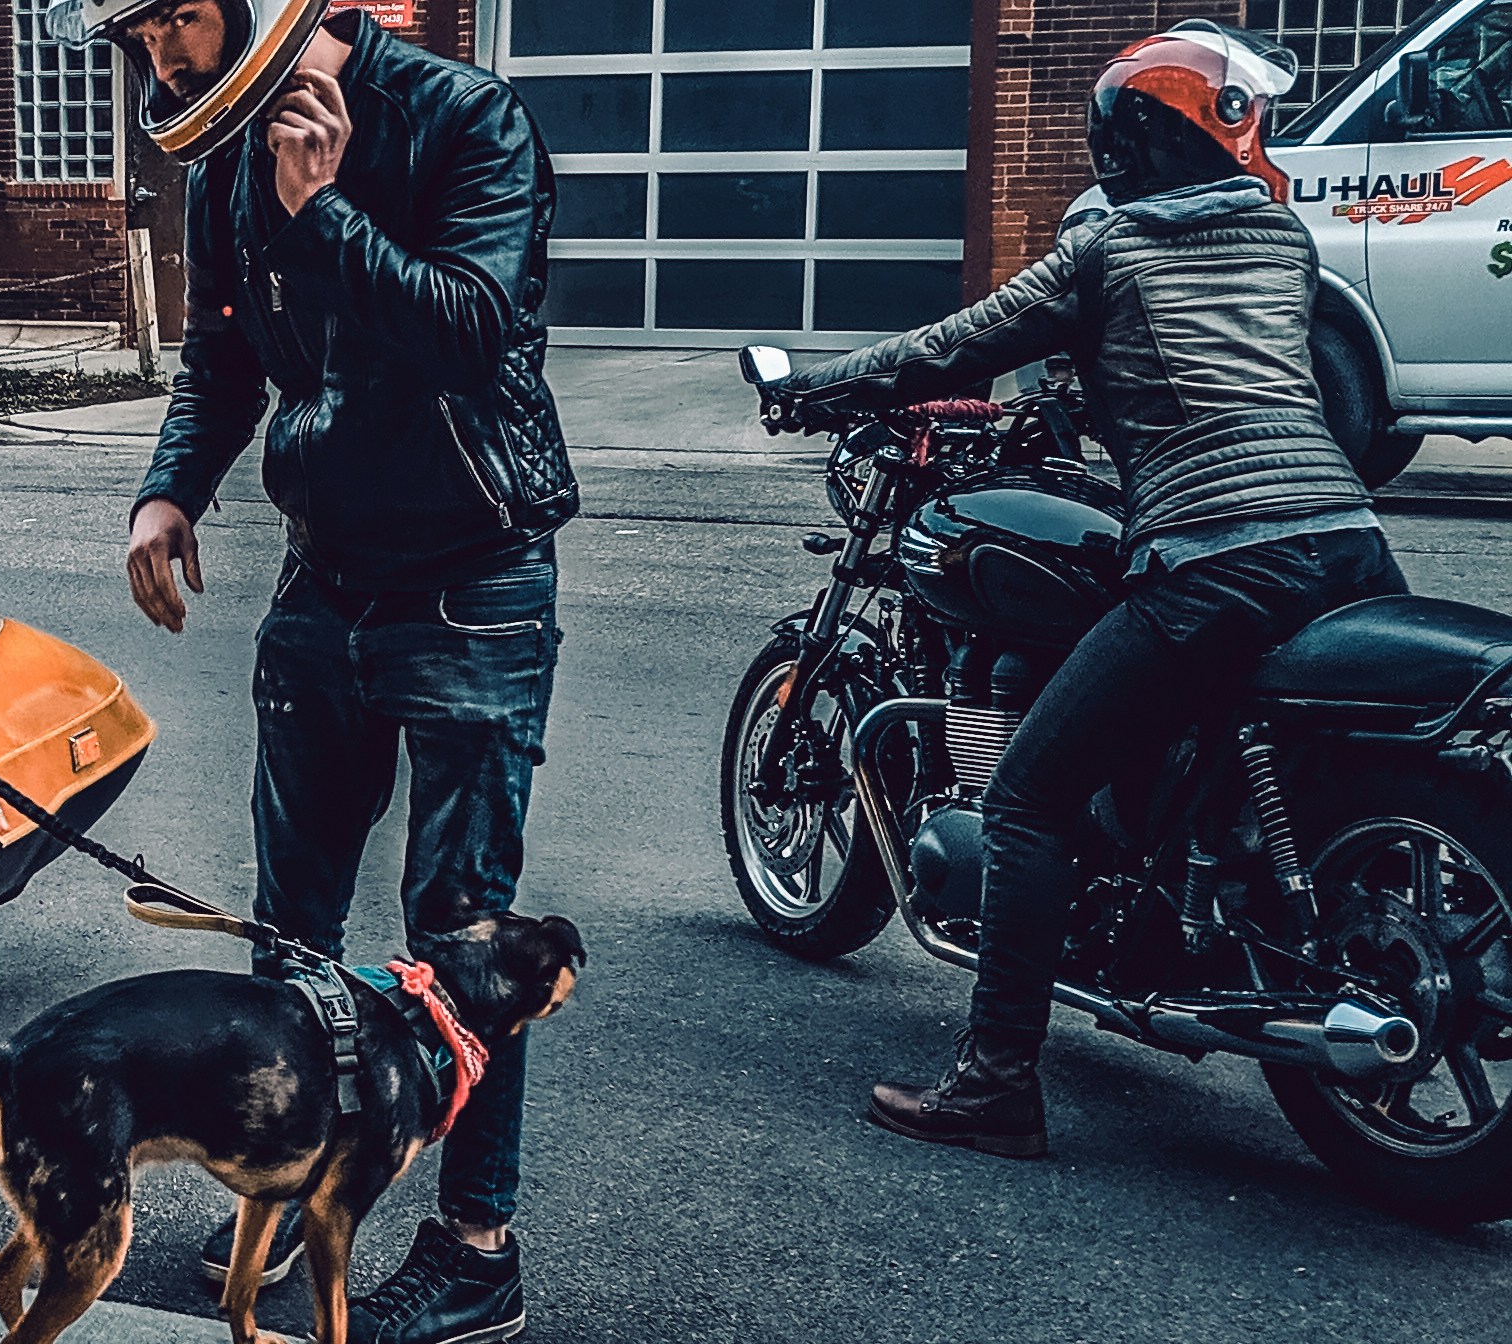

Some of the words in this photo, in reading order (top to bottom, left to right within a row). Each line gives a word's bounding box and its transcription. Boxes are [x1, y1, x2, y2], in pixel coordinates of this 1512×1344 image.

[1293, 172, 1454, 203] U-HAUL
[1353, 204, 1387, 215] TRUCK
[1389, 203, 1423, 213] SHARE
[1425, 202, 1449, 212] 24/7
